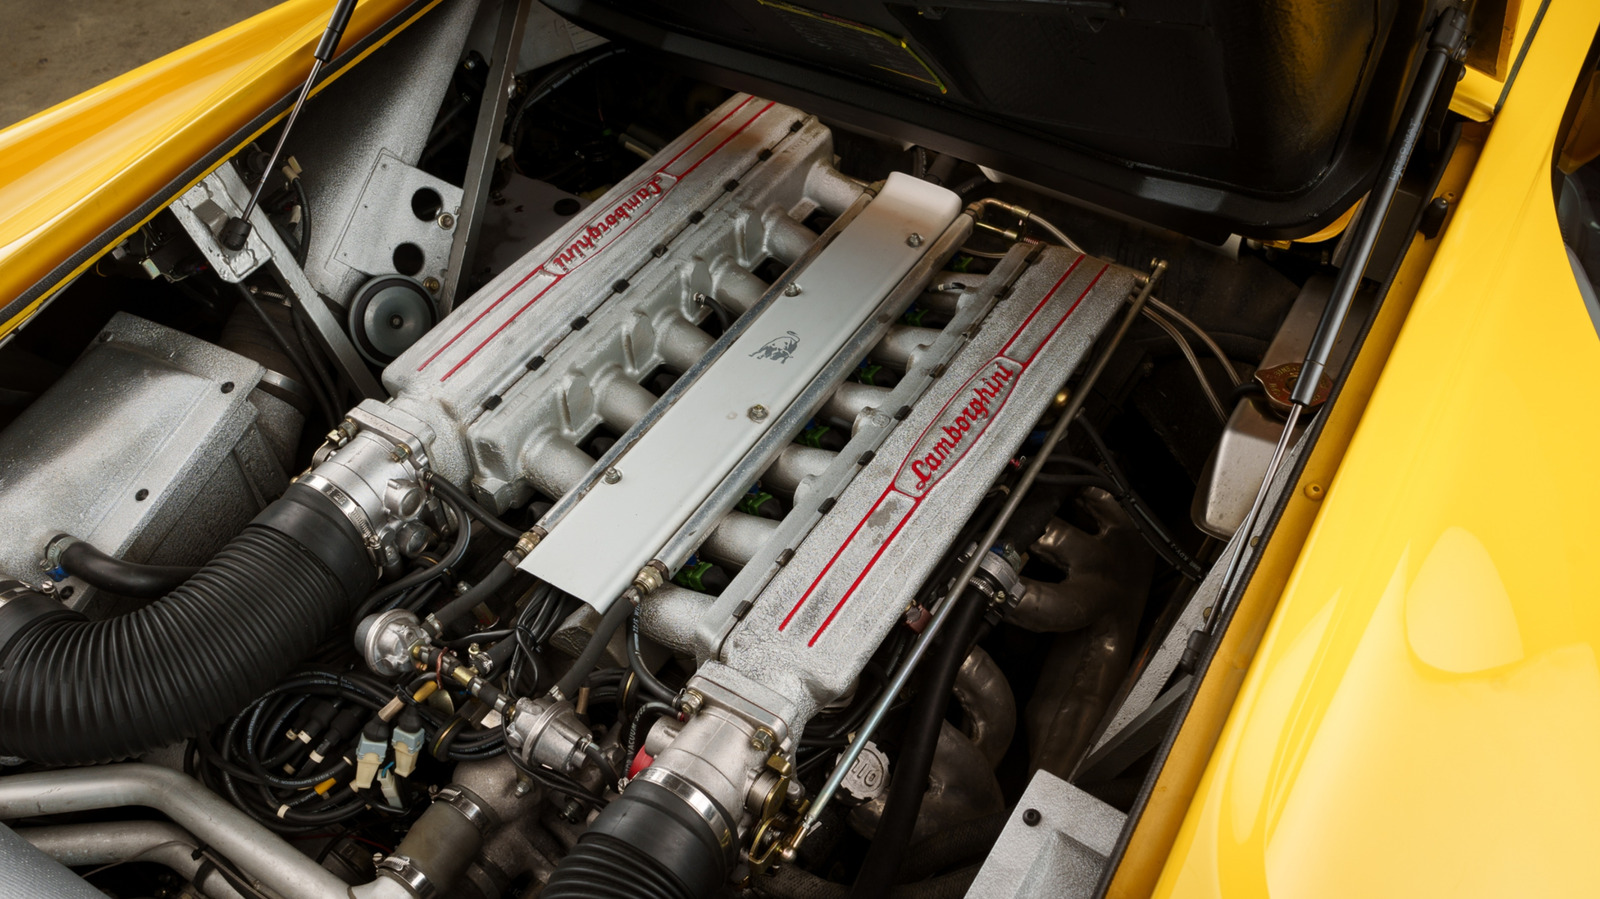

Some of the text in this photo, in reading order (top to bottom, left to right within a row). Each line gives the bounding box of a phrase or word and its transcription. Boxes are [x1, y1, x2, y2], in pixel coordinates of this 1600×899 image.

[552, 176, 663, 272] Lamborghini
[911, 361, 1014, 490] Lamborghini
[627, 722, 638, 756] VACUUM
[851, 757, 879, 788] OIL
